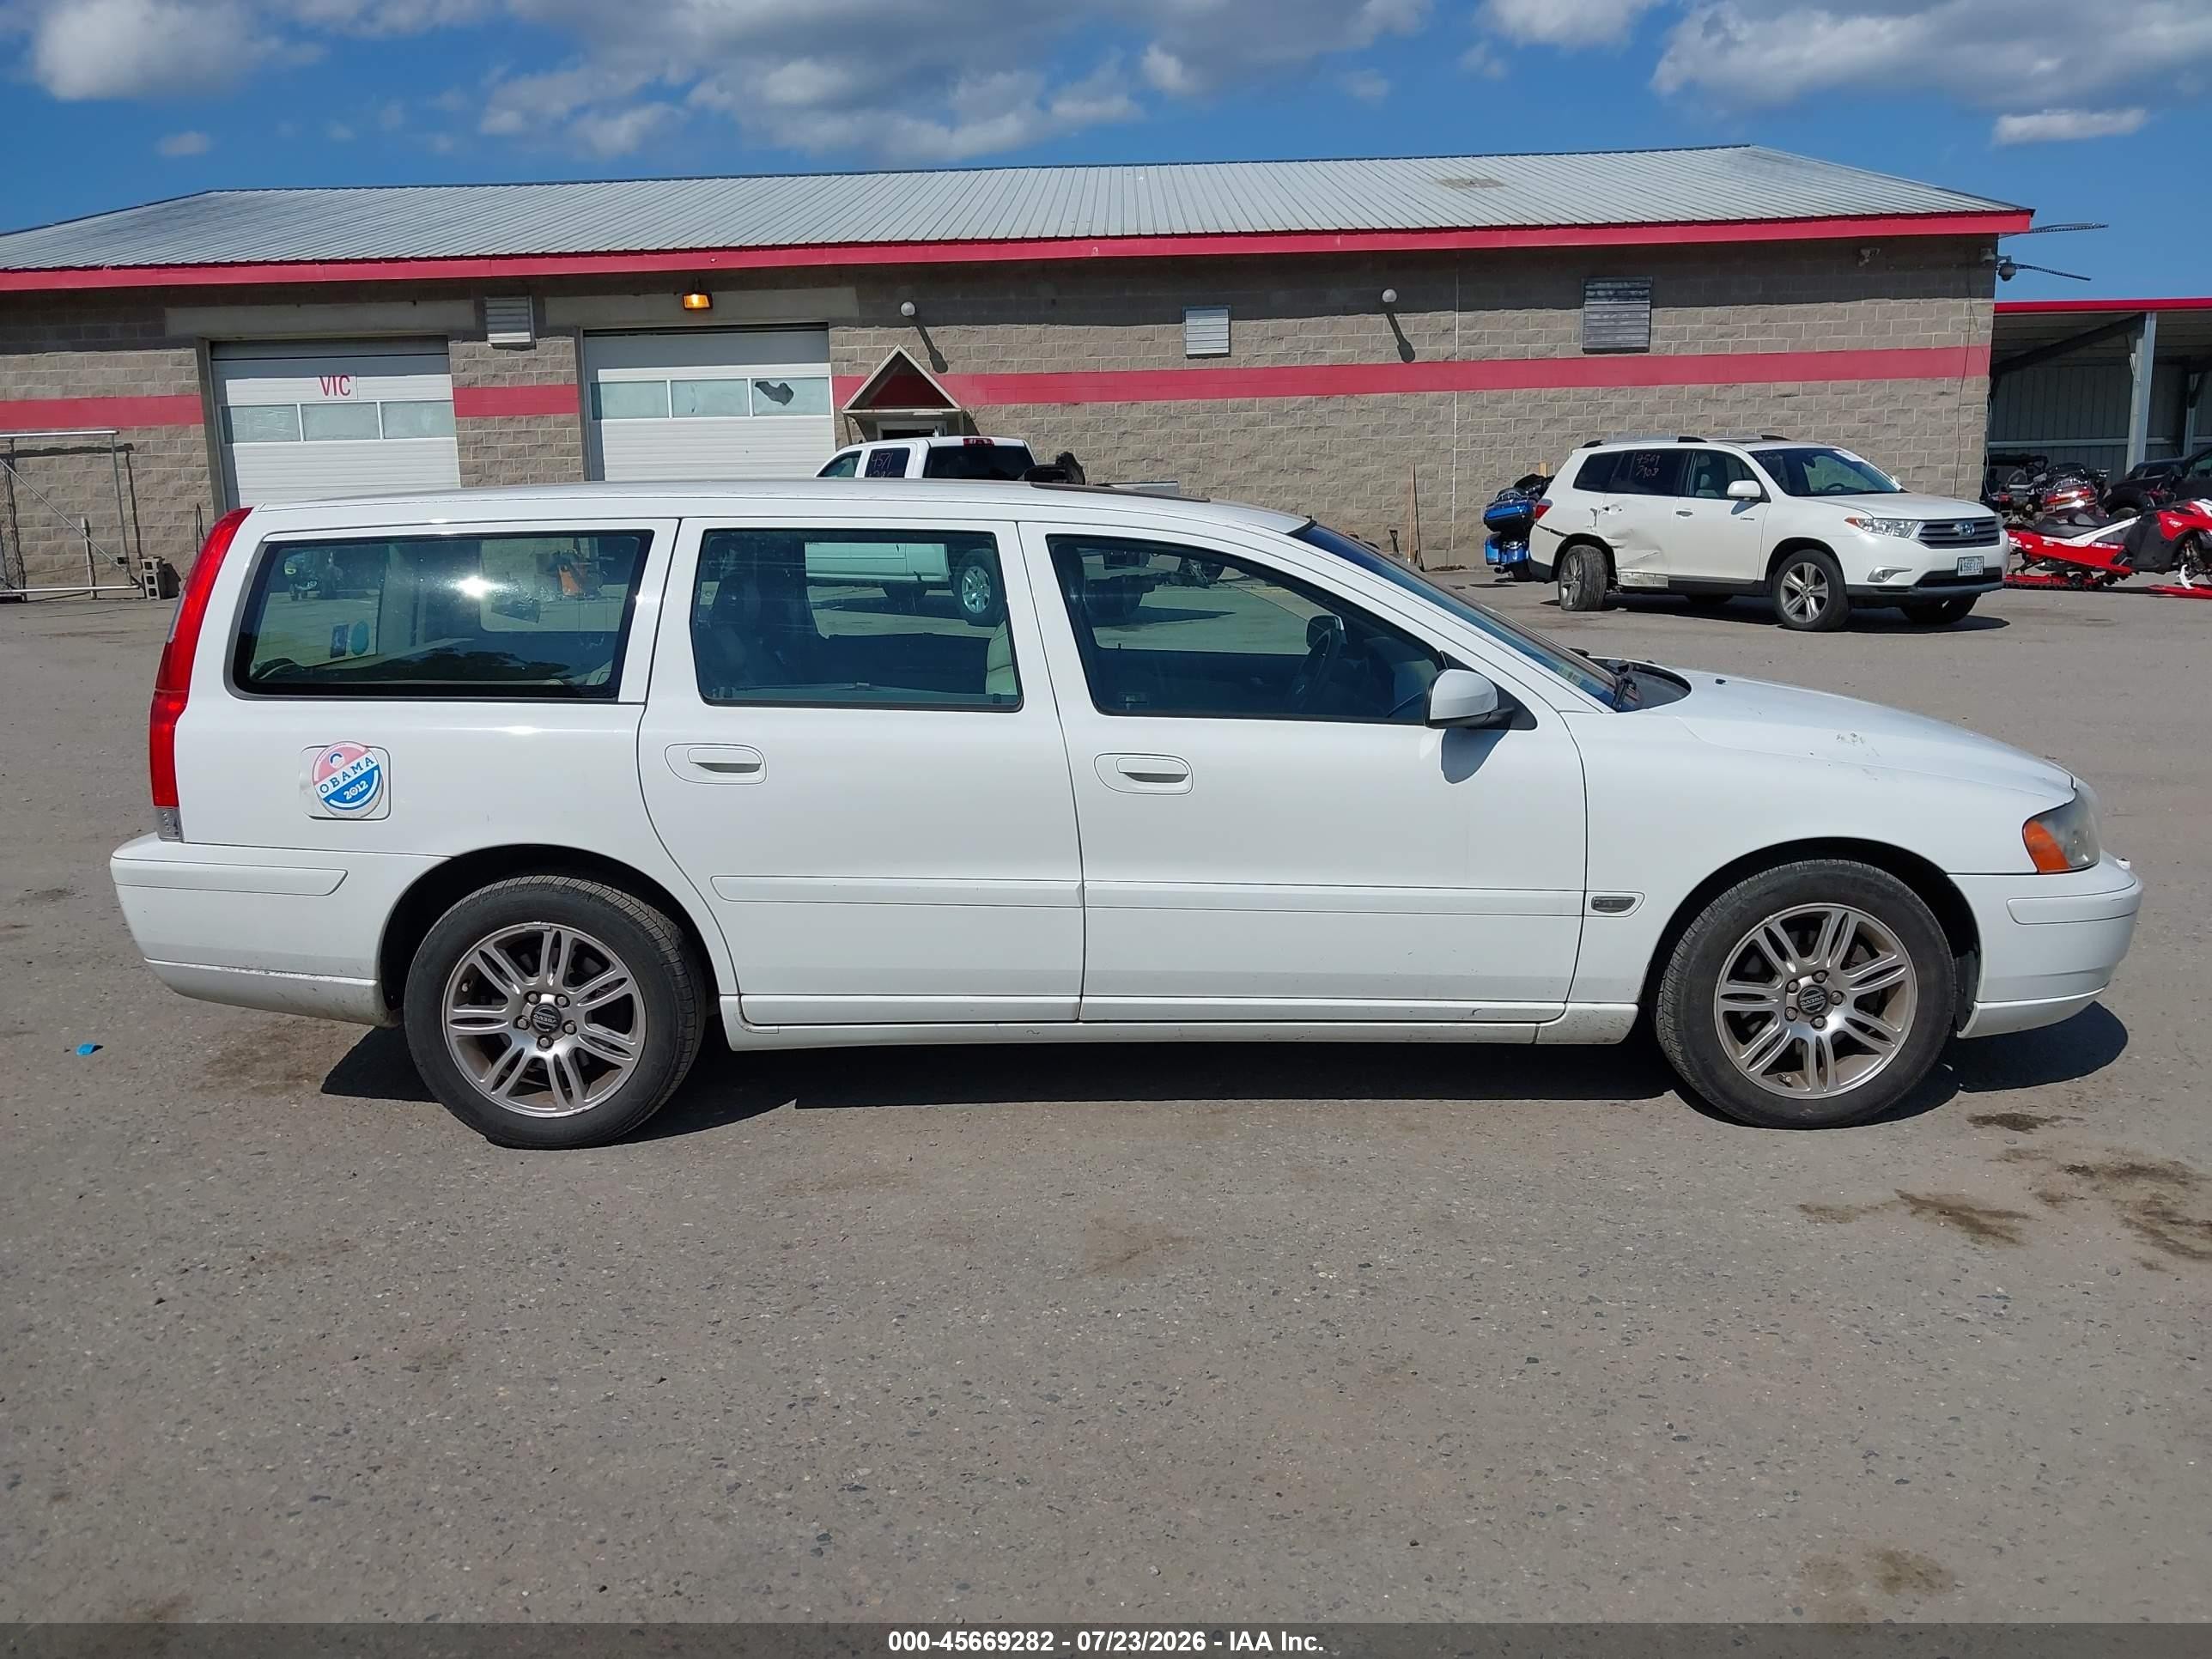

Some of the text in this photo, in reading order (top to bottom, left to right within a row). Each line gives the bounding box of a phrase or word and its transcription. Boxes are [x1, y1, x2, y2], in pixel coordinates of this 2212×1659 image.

[319, 374, 351, 397] VIC
[319, 757, 374, 794] OBAMA
[343, 780, 369, 800] 2012
[533, 1013, 557, 1024] VOLVO
